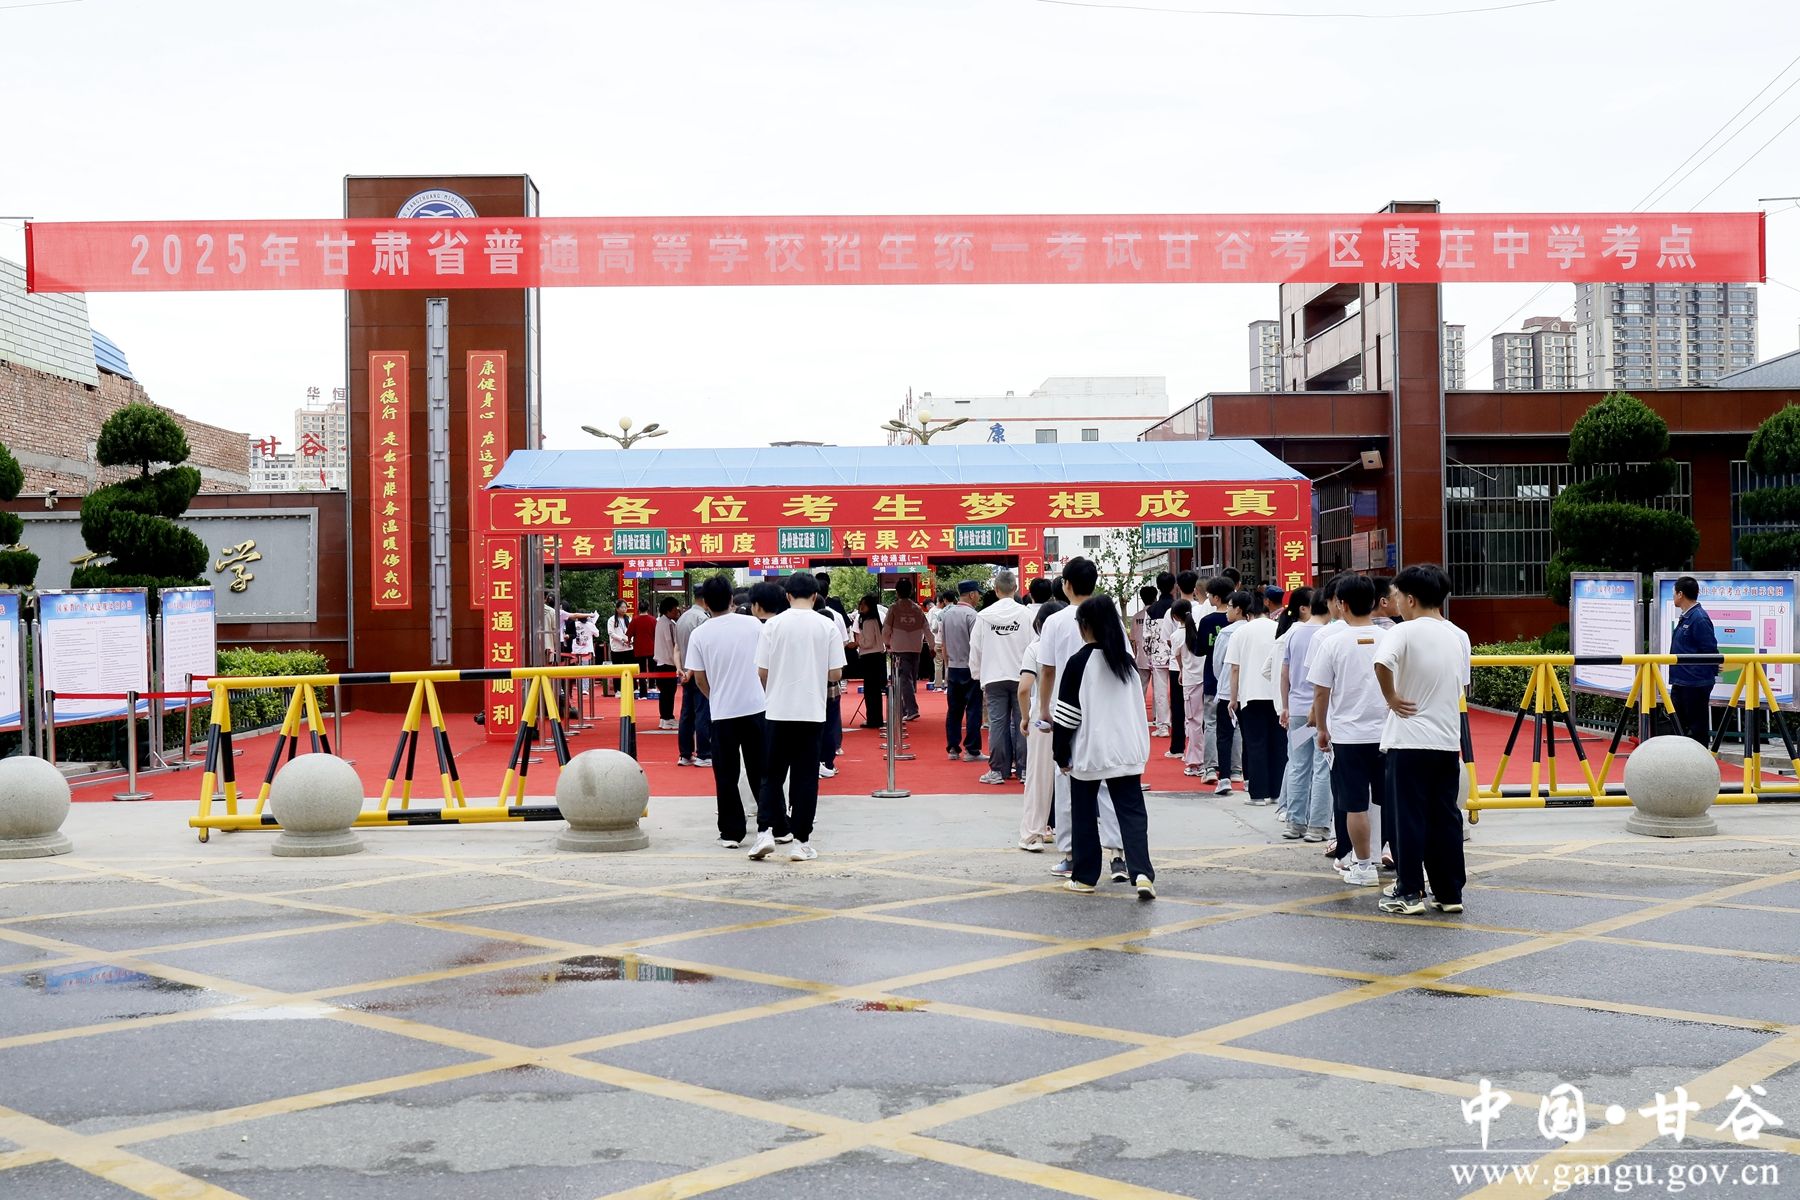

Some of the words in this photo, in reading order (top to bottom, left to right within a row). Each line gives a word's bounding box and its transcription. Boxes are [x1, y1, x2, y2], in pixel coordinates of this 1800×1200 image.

[131, 223, 1696, 277] 2025年甘肃省普通高等学校招生统一考试甘谷考区康庄中学考点
[477, 360, 497, 420] 康健身心
[252, 432, 346, 459] 甘谷
[987, 422, 1006, 444] 康
[513, 488, 1278, 526] 祝各位考生梦想成真
[543, 532, 756, 557] 守各试制度
[832, 528, 1029, 551] 结果公平正
[1283, 540, 1305, 592] 学高
[491, 548, 515, 725] 身正通过顺利
